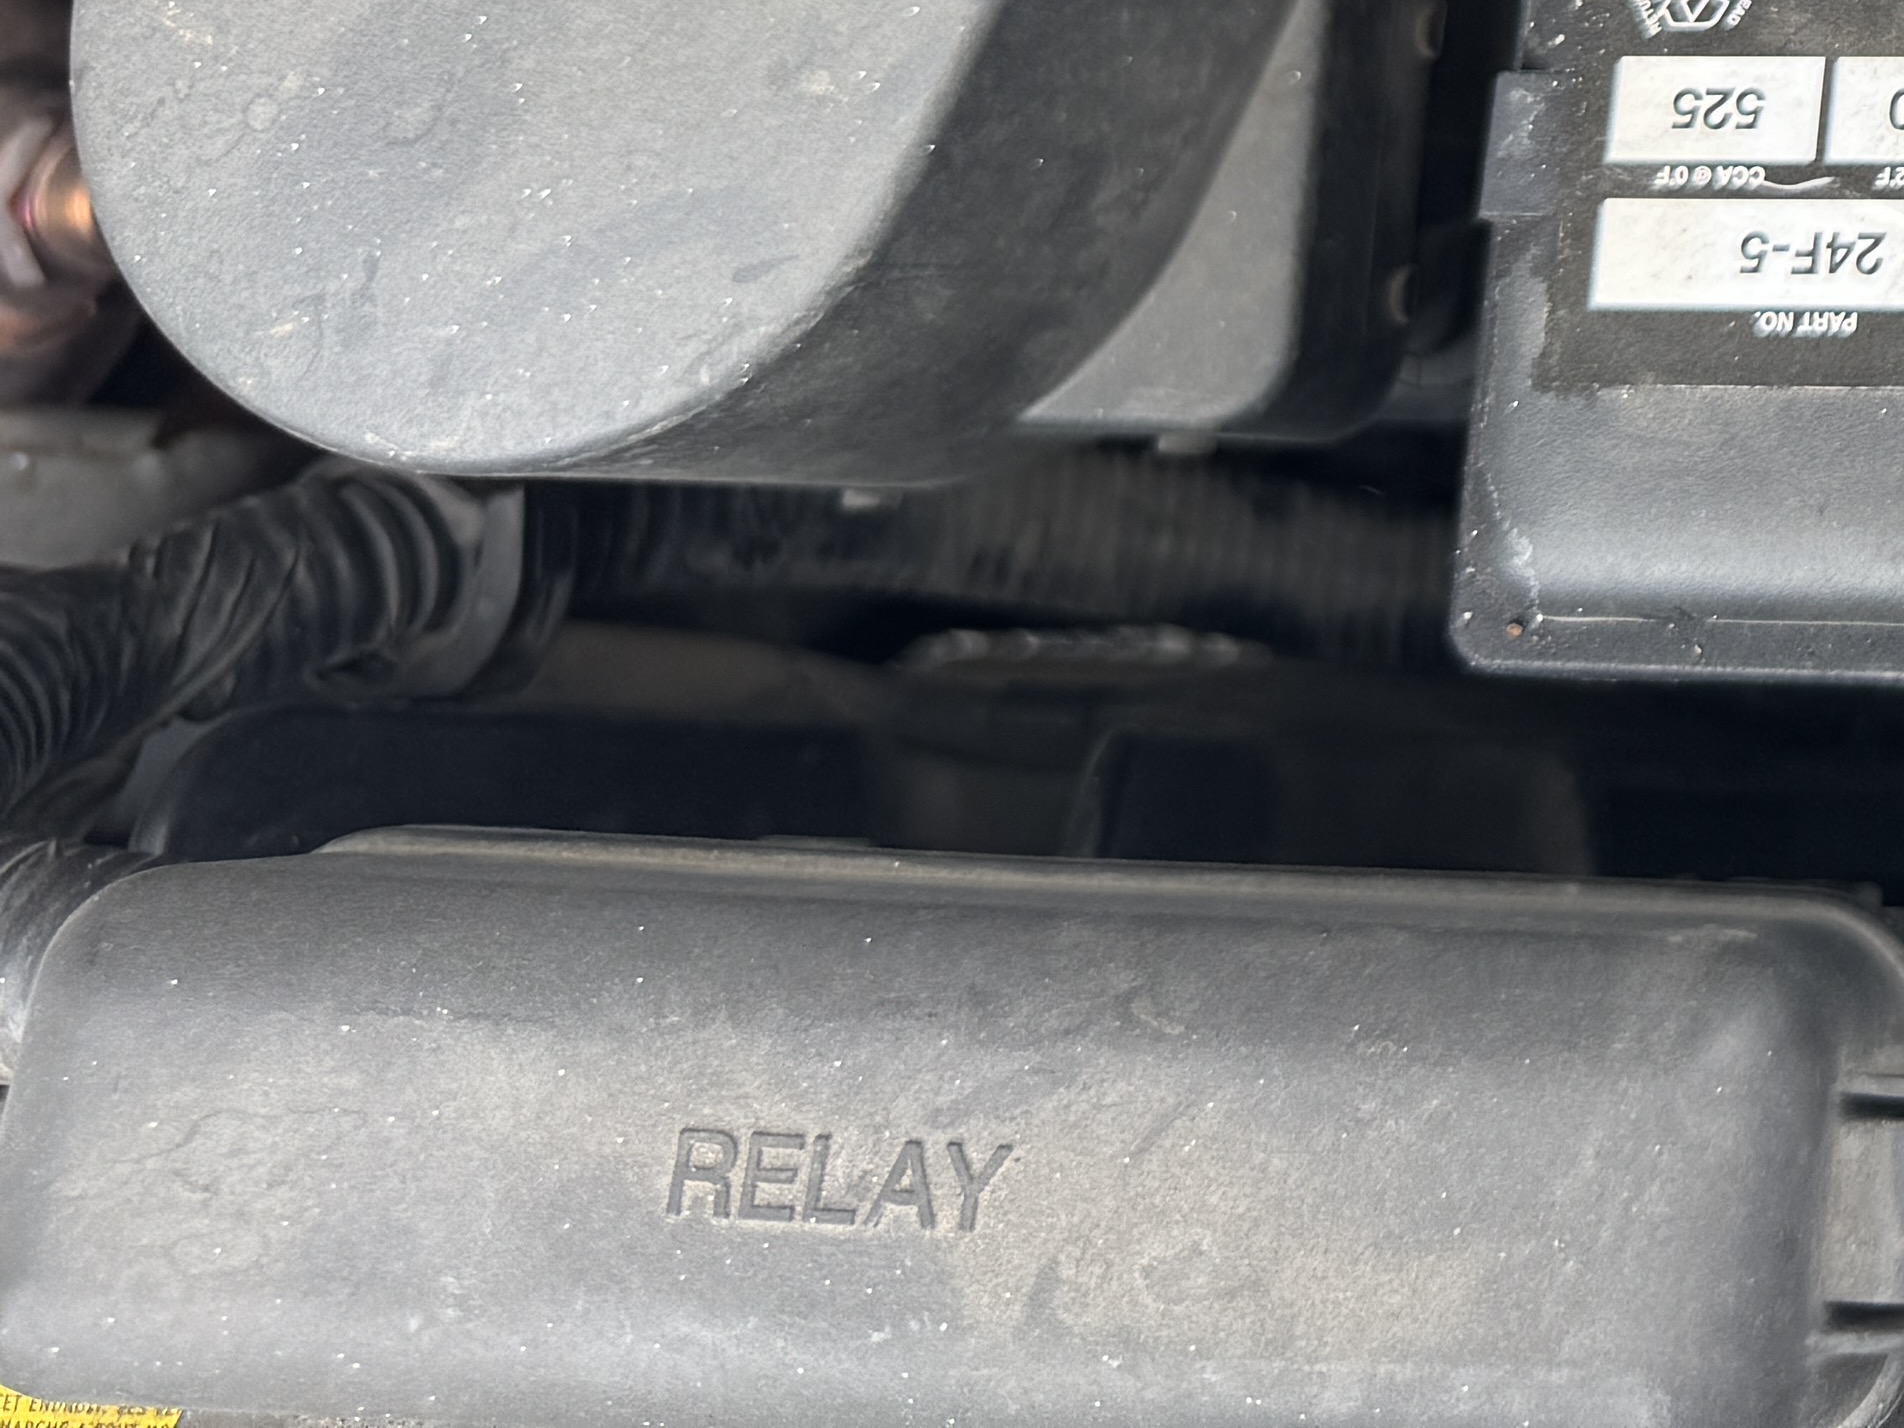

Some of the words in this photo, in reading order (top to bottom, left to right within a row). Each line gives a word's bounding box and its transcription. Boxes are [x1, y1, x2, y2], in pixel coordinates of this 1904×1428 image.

[1671, 87, 1766, 131] 525
[1717, 165, 1766, 186] CCA
[1739, 230, 1887, 276] 24F-5
[1753, 311, 1793, 334] NO.
[1798, 311, 1858, 334] PART
[665, 1127, 1014, 1232] RELAY
